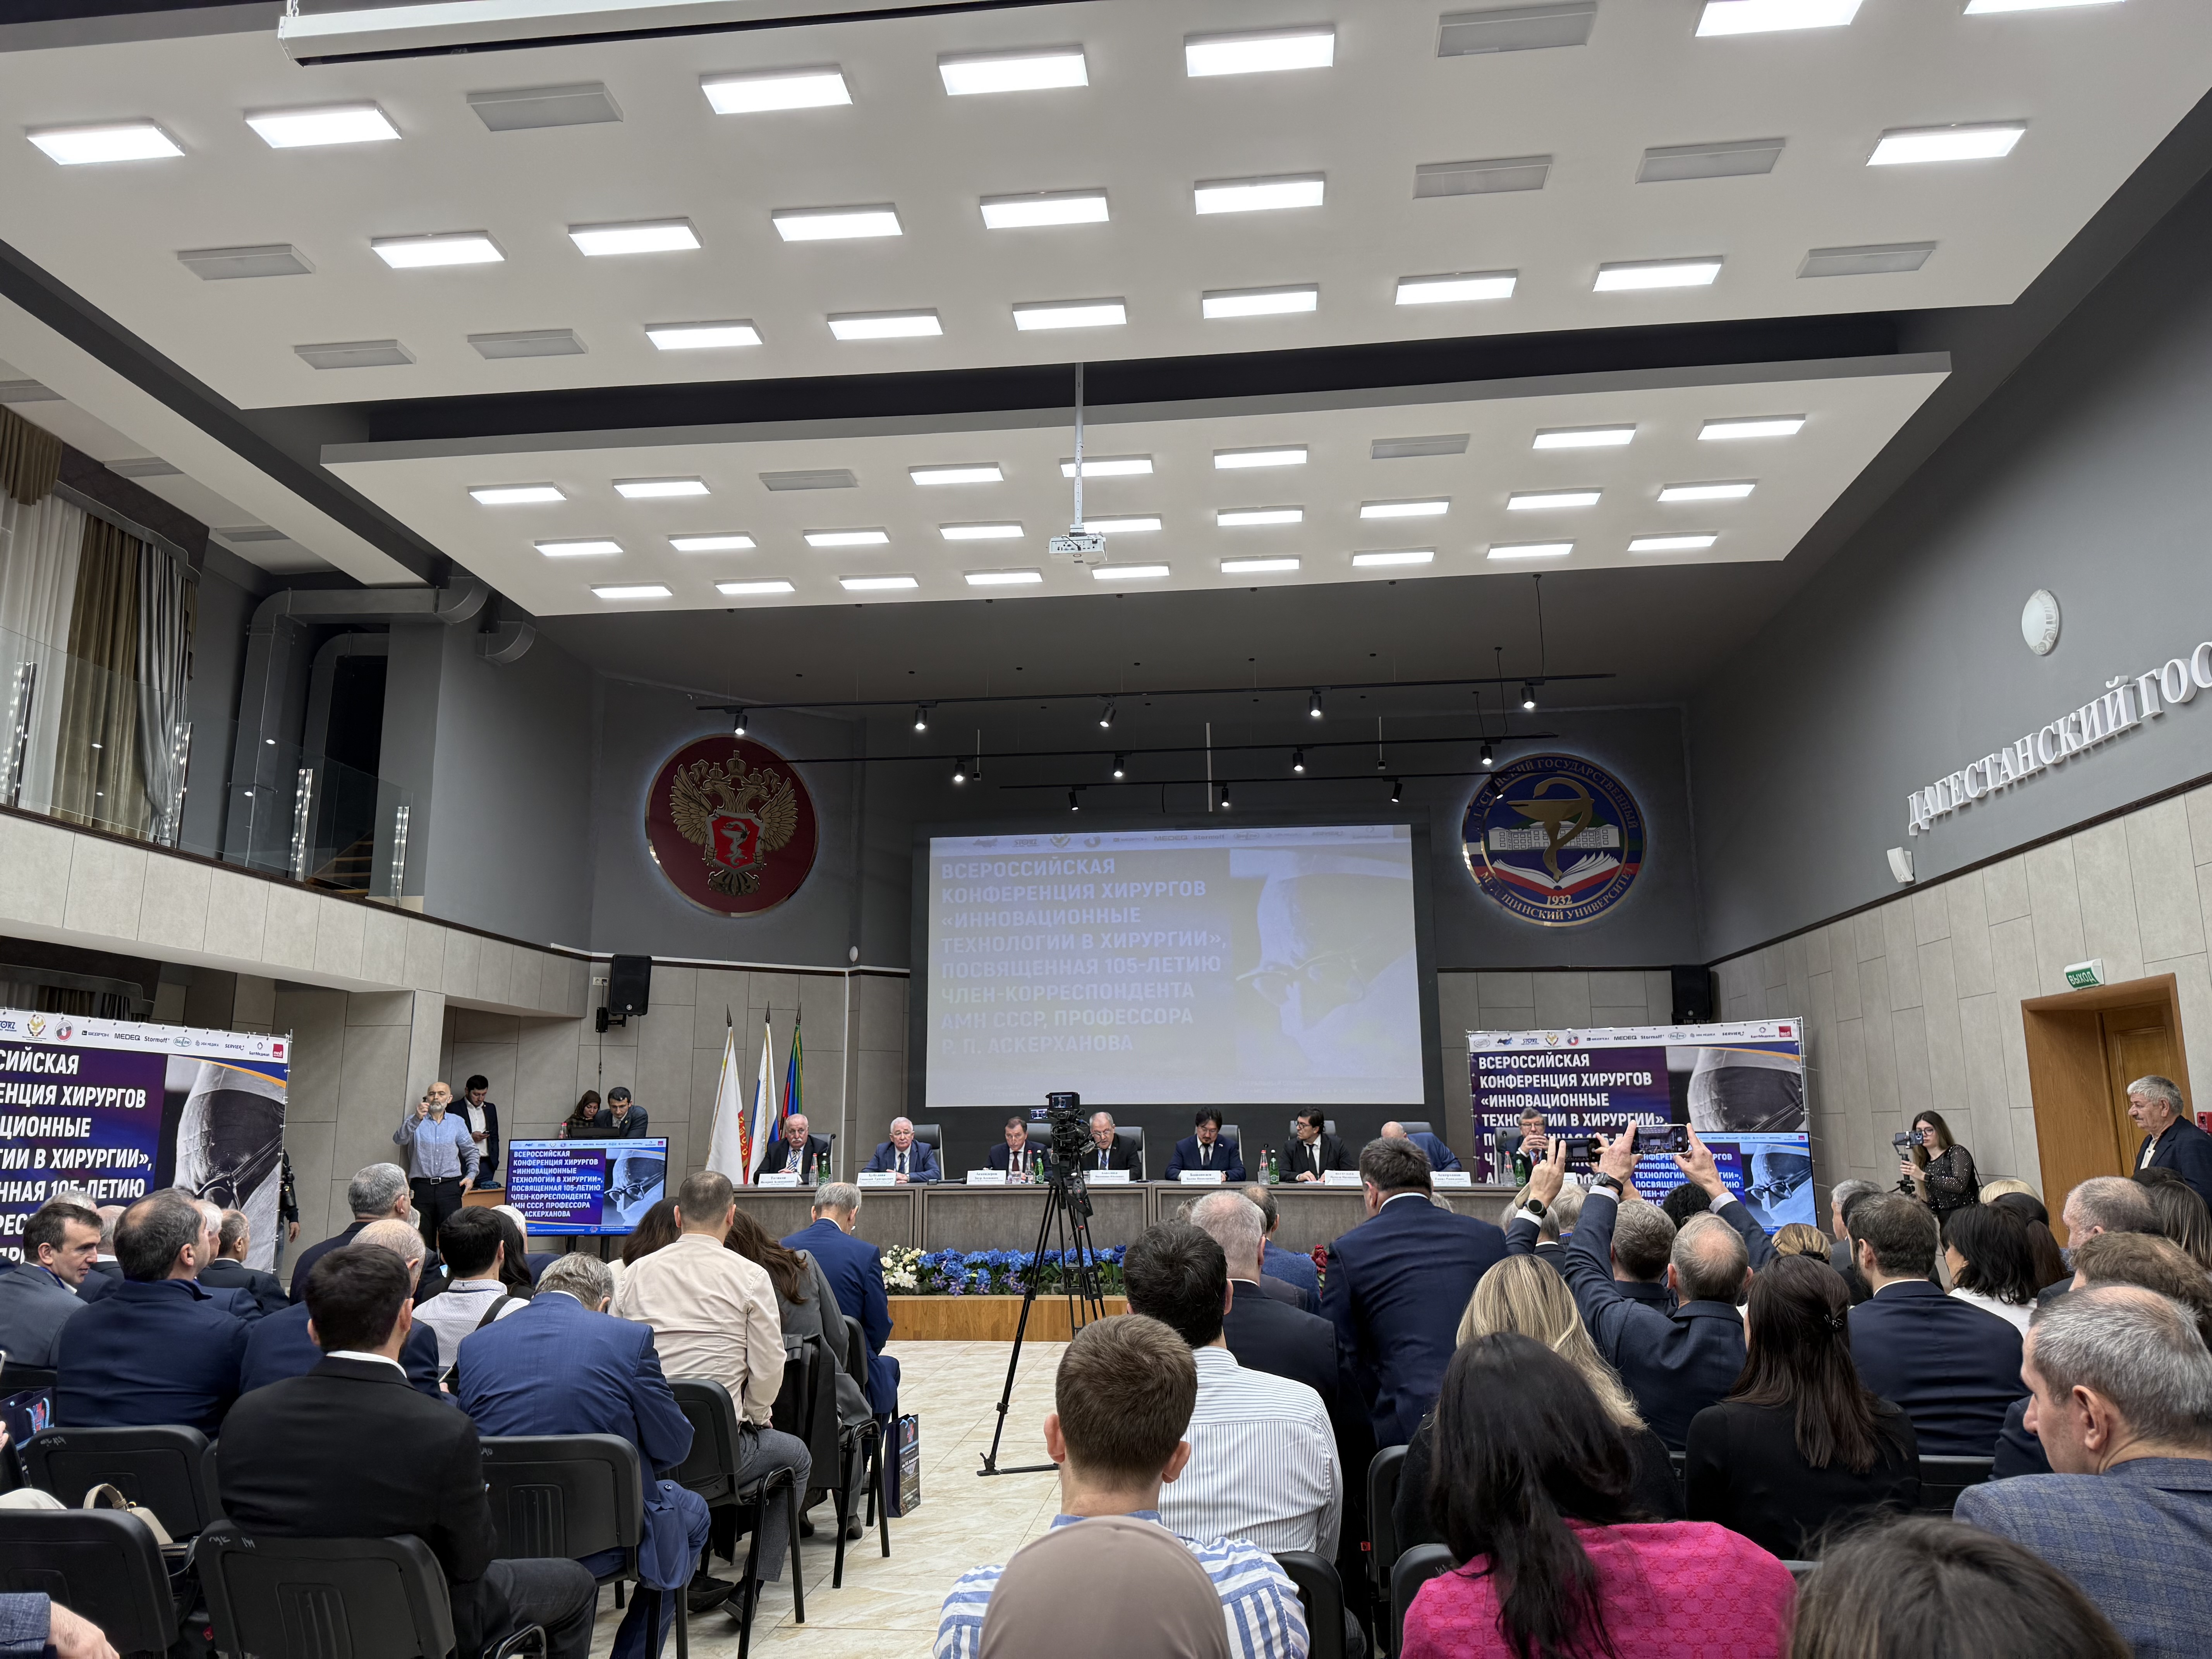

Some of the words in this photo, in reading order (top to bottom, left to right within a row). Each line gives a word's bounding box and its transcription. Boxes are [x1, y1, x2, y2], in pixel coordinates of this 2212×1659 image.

[1907, 675, 2141, 836] ДАГЕСТАНСКИЙ
[1537, 759, 1639, 829] ГОСУДАРСТВЕННЫЙ
[942, 857, 1115, 879] ВСЕРОССИЙСКАЯ
[942, 883, 1094, 903] КОНФЕРЕНЦИЯ
[1101, 881, 1206, 898] ХИРУРГОВ
[1547, 895, 1573, 906] 1932
[1567, 867, 1633, 920] УНИВЕРСИТЕТ
[941, 907, 1140, 928] «ИННОВАЦИОННЫЕ
[941, 934, 1074, 953] ТЕХНОЛОГИИ
[1082, 934, 1094, 949] В
[1101, 930, 1226, 949] ХИРУРГИИ»,
[942, 959, 1098, 978] ПОСВЯЩЕННАЯ
[1105, 955, 1221, 974] 105-ЛЕТИЮ
[2068, 971, 2096, 985] ВЫХОД
[942, 982, 1195, 1004] ЧЛЕН-КОРРЕСПОНДЕНТА
[0, 1021, 15, 1029] ORZ
[941, 1012, 986, 1029] АМН
[993, 1011, 1047, 1029] СССР,
[1054, 1007, 1193, 1026] ПРОФЕССОРА
[963, 1038, 981, 1054] П.
[987, 1034, 1133, 1053] АСКЕРХАНОВА
[1479, 1052, 1590, 1069] ВСЕРОССИЙСКАЯ
[1480, 1073, 1577, 1089] КОНФЕРЕНЦИЯ
[1581, 1072, 1652, 1086] ХИРУРГОВ
[60, 1085, 146, 1108] ХИРУРГОВ
[1481, 1093, 1609, 1108] «ИННОВАЦИОННЫЕ
[1570, 1113, 1579, 1126] В
[34, 1149, 46, 1169] В
[50, 1149, 152, 1171] ХИРУРГИИ»,
